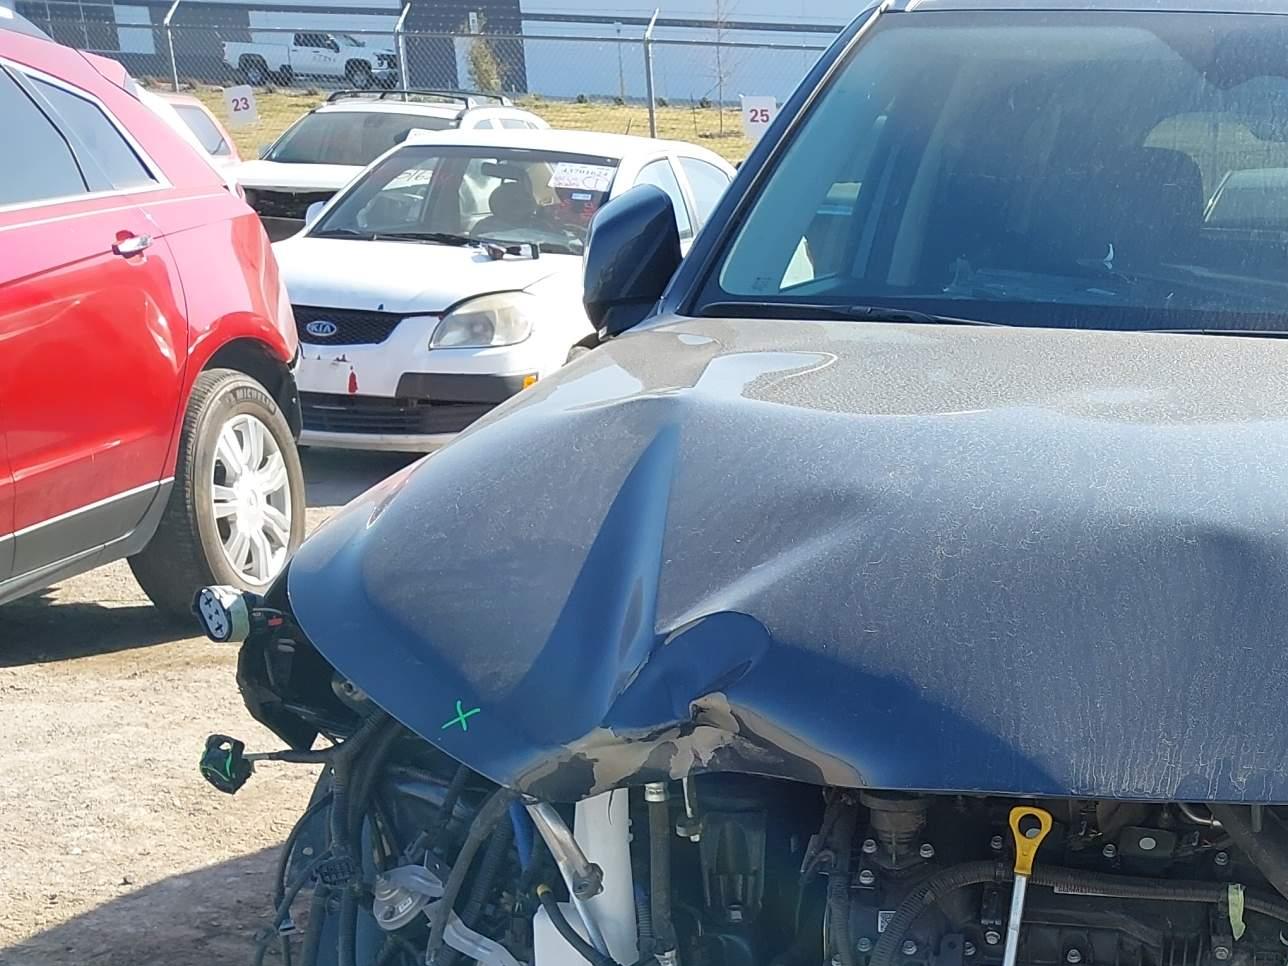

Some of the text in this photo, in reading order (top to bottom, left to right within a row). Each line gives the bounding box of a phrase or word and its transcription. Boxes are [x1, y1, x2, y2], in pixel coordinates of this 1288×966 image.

[231, 97, 250, 112] 23
[749, 108, 770, 123] 25
[235, 387, 276, 414] MICHELIN
